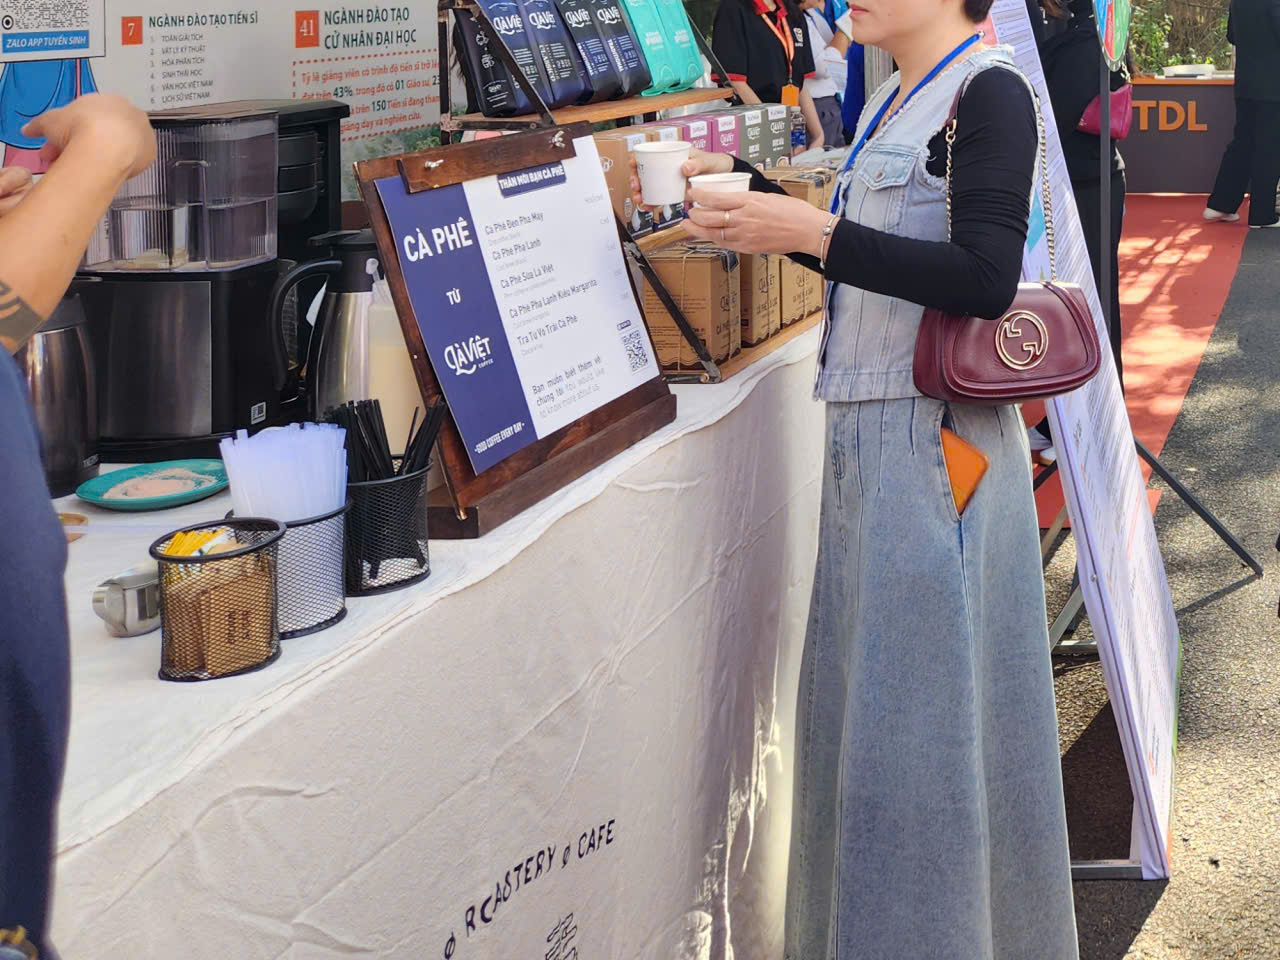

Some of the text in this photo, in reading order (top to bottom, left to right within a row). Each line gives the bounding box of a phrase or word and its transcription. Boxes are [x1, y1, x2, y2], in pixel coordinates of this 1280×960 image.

[149, 14, 184, 28] NGÀNH
[187, 12, 207, 26] ĐÀO
[209, 14, 227, 28] TẠO
[229, 10, 248, 25] TIẾN
[324, 6, 410, 25] NGÀNH ĐÀO TẠO
[128, 23, 135, 37] 7
[299, 19, 314, 36] 41
[6, 37, 28, 49] ZALO
[29, 36, 43, 47] APP
[69, 35, 86, 45] SINH
[324, 29, 417, 49] CỬ NHÂN ĐẠI HỌC
[395, 79, 404, 90] 01
[372, 100, 386, 112] 150
[1131, 100, 1208, 131] TDL
[499, 176, 518, 189] THÂN
[517, 172, 529, 185] MỜI
[529, 171, 543, 183] BẠN
[542, 167, 552, 179] CÀ
[403, 227, 433, 262] CÀ
[431, 216, 473, 254] PHÊ
[446, 288, 461, 305] TỪ
[578, 818, 615, 859] CAFE
